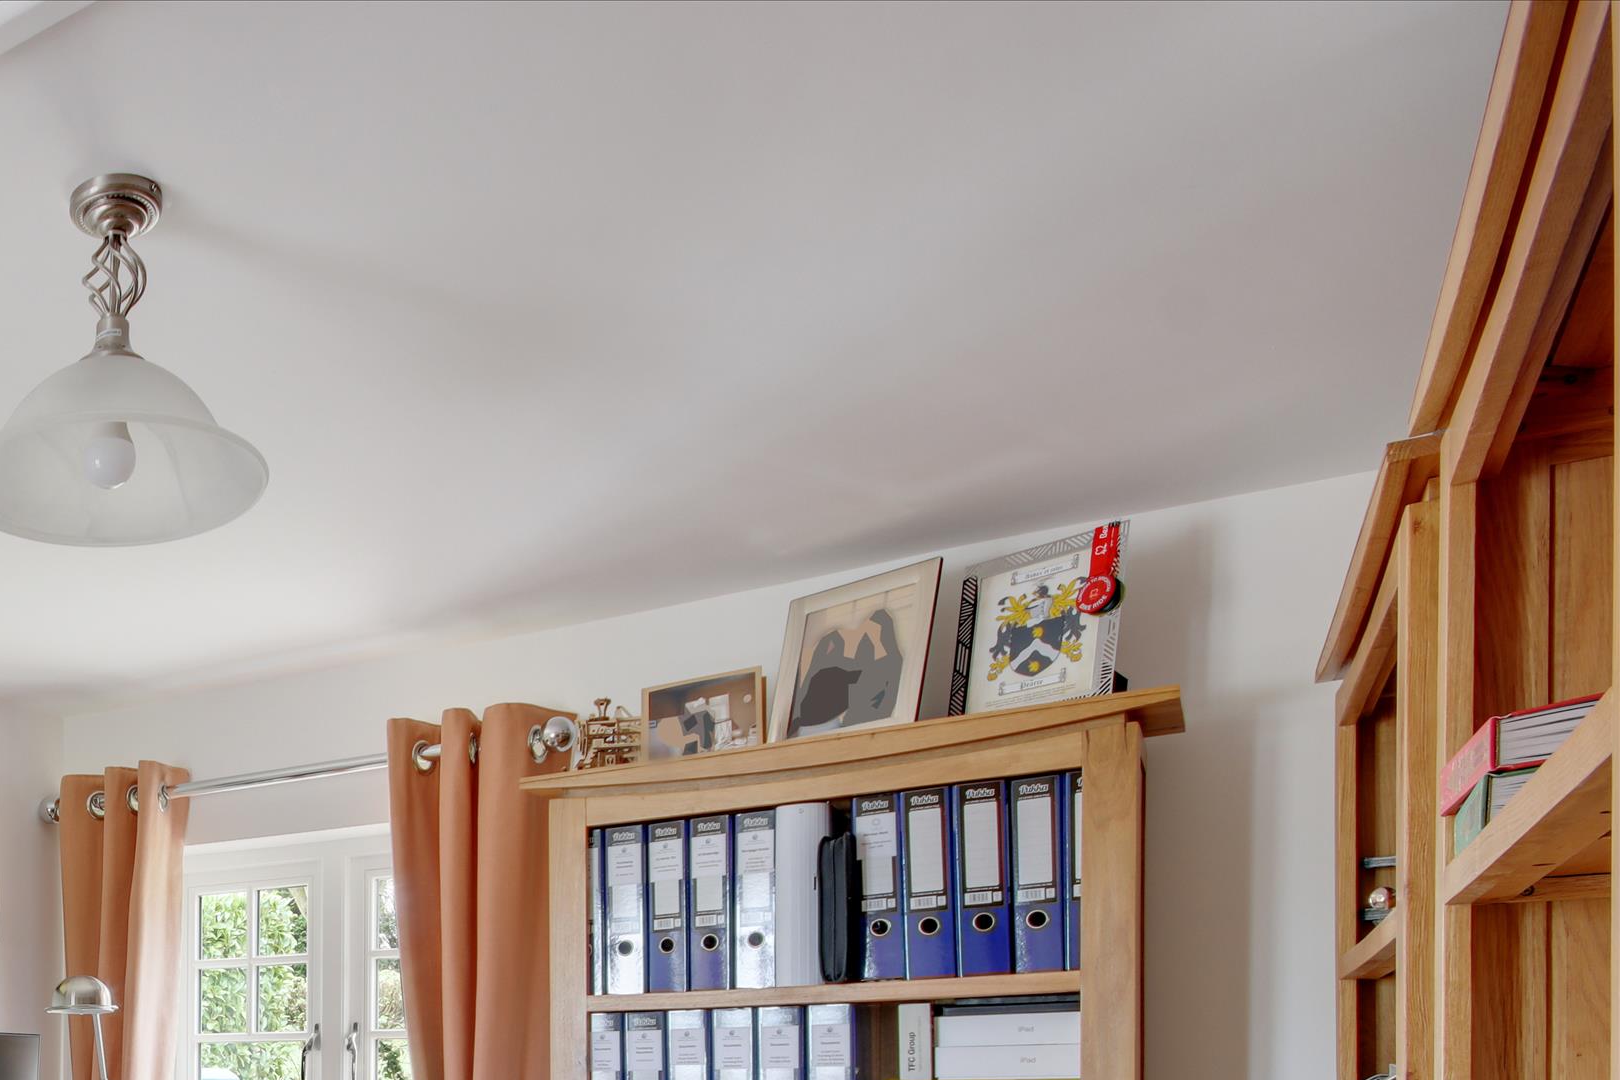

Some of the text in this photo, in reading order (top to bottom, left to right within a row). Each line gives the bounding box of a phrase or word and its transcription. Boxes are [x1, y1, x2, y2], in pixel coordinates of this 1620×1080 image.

[1017, 1025, 1034, 1033] iPad
[907, 1031, 917, 1072] TFC Group
